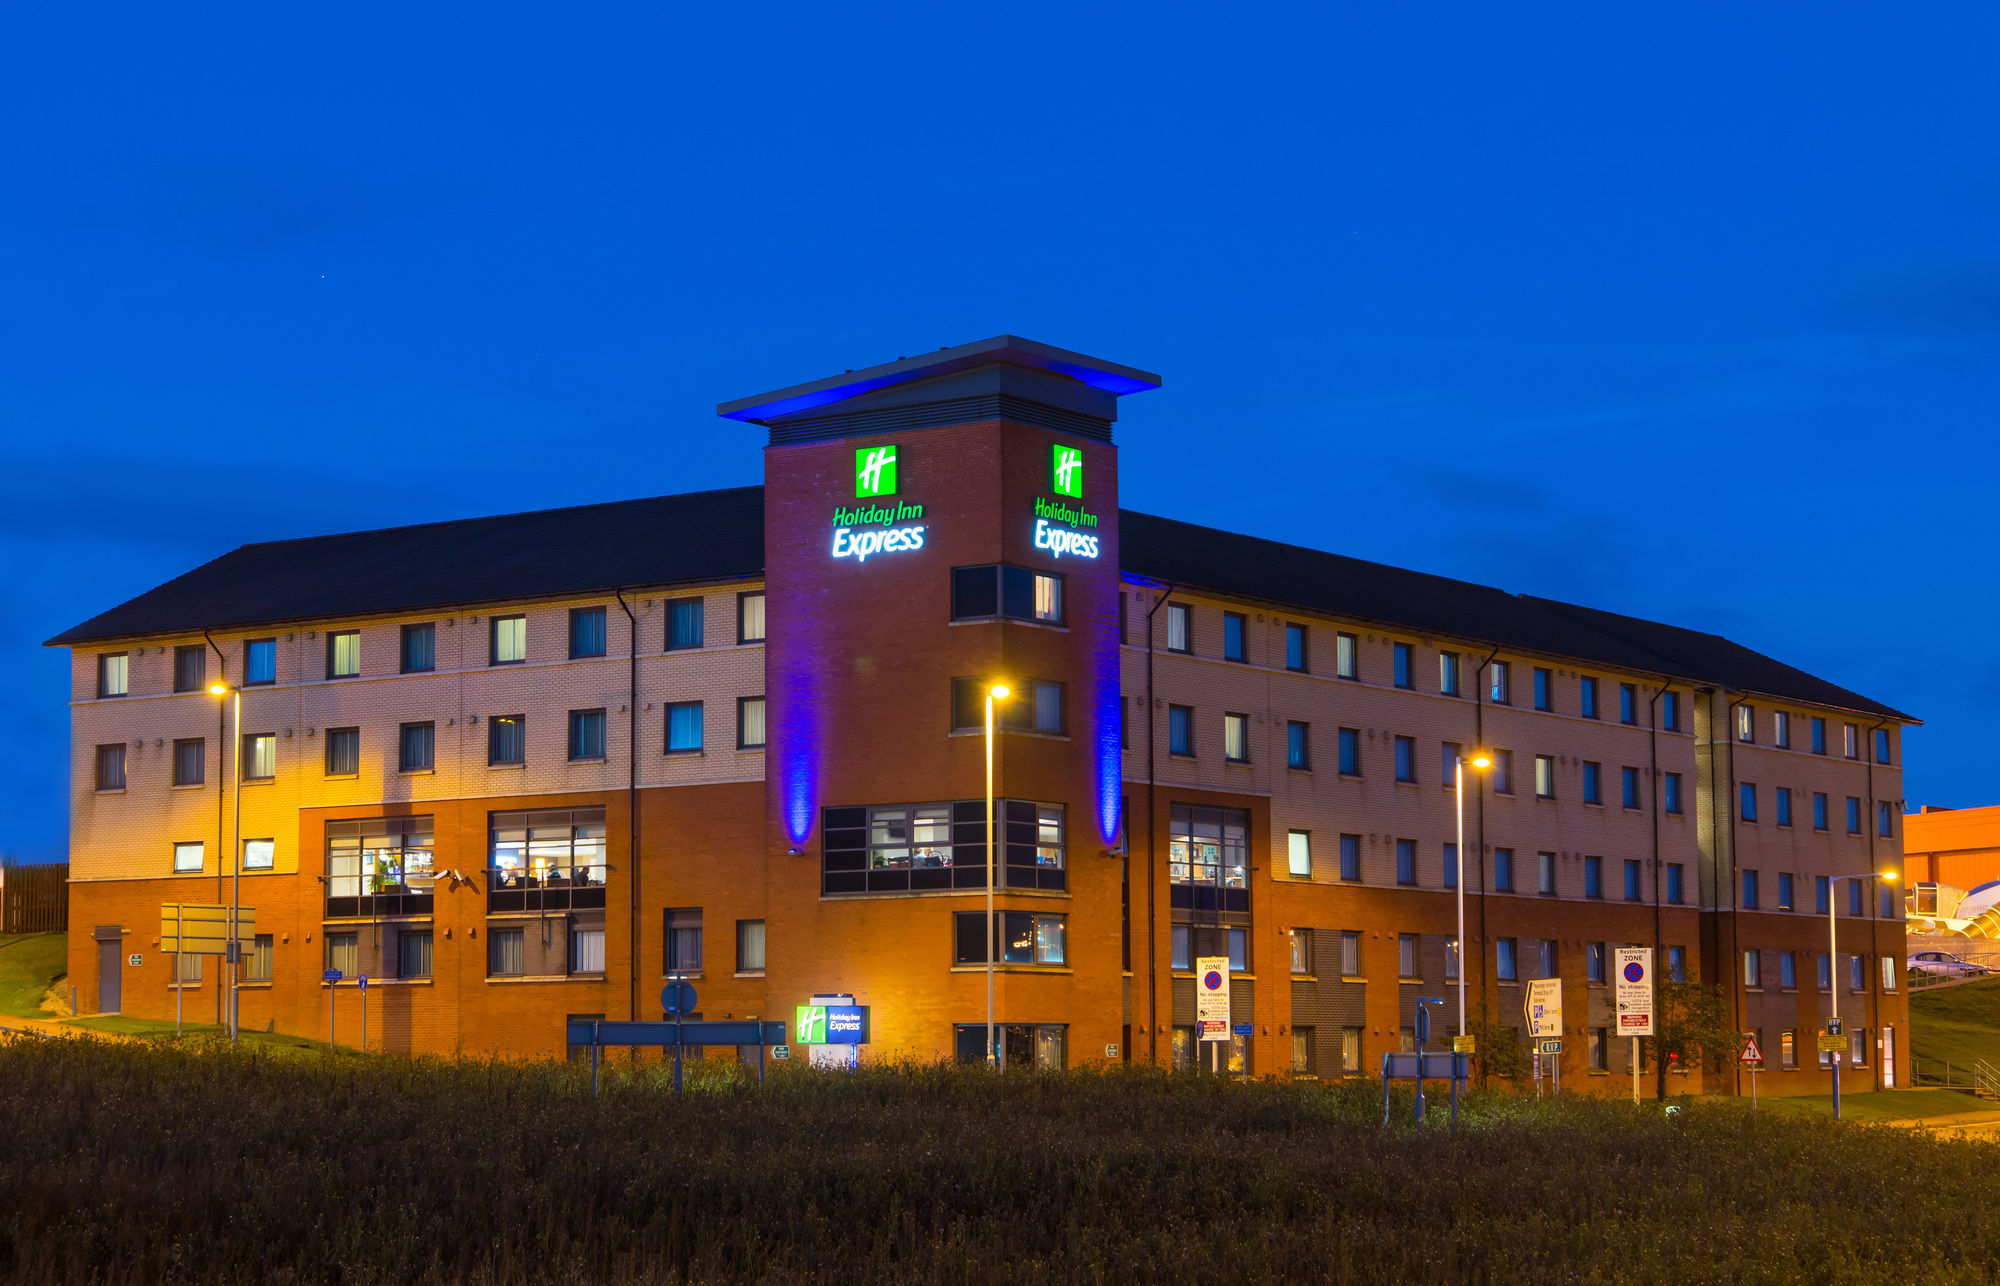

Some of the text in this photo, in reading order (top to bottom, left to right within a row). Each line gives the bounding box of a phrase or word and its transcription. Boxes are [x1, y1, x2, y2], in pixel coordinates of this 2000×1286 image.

[832, 500, 923, 527] Holiday Inn
[1035, 496, 1098, 528] Holiday Inn
[832, 526, 925, 562] Express
[1035, 519, 1099, 558] Express
[829, 1021, 861, 1032] Express
[830, 1014, 850, 1022] Holiday
